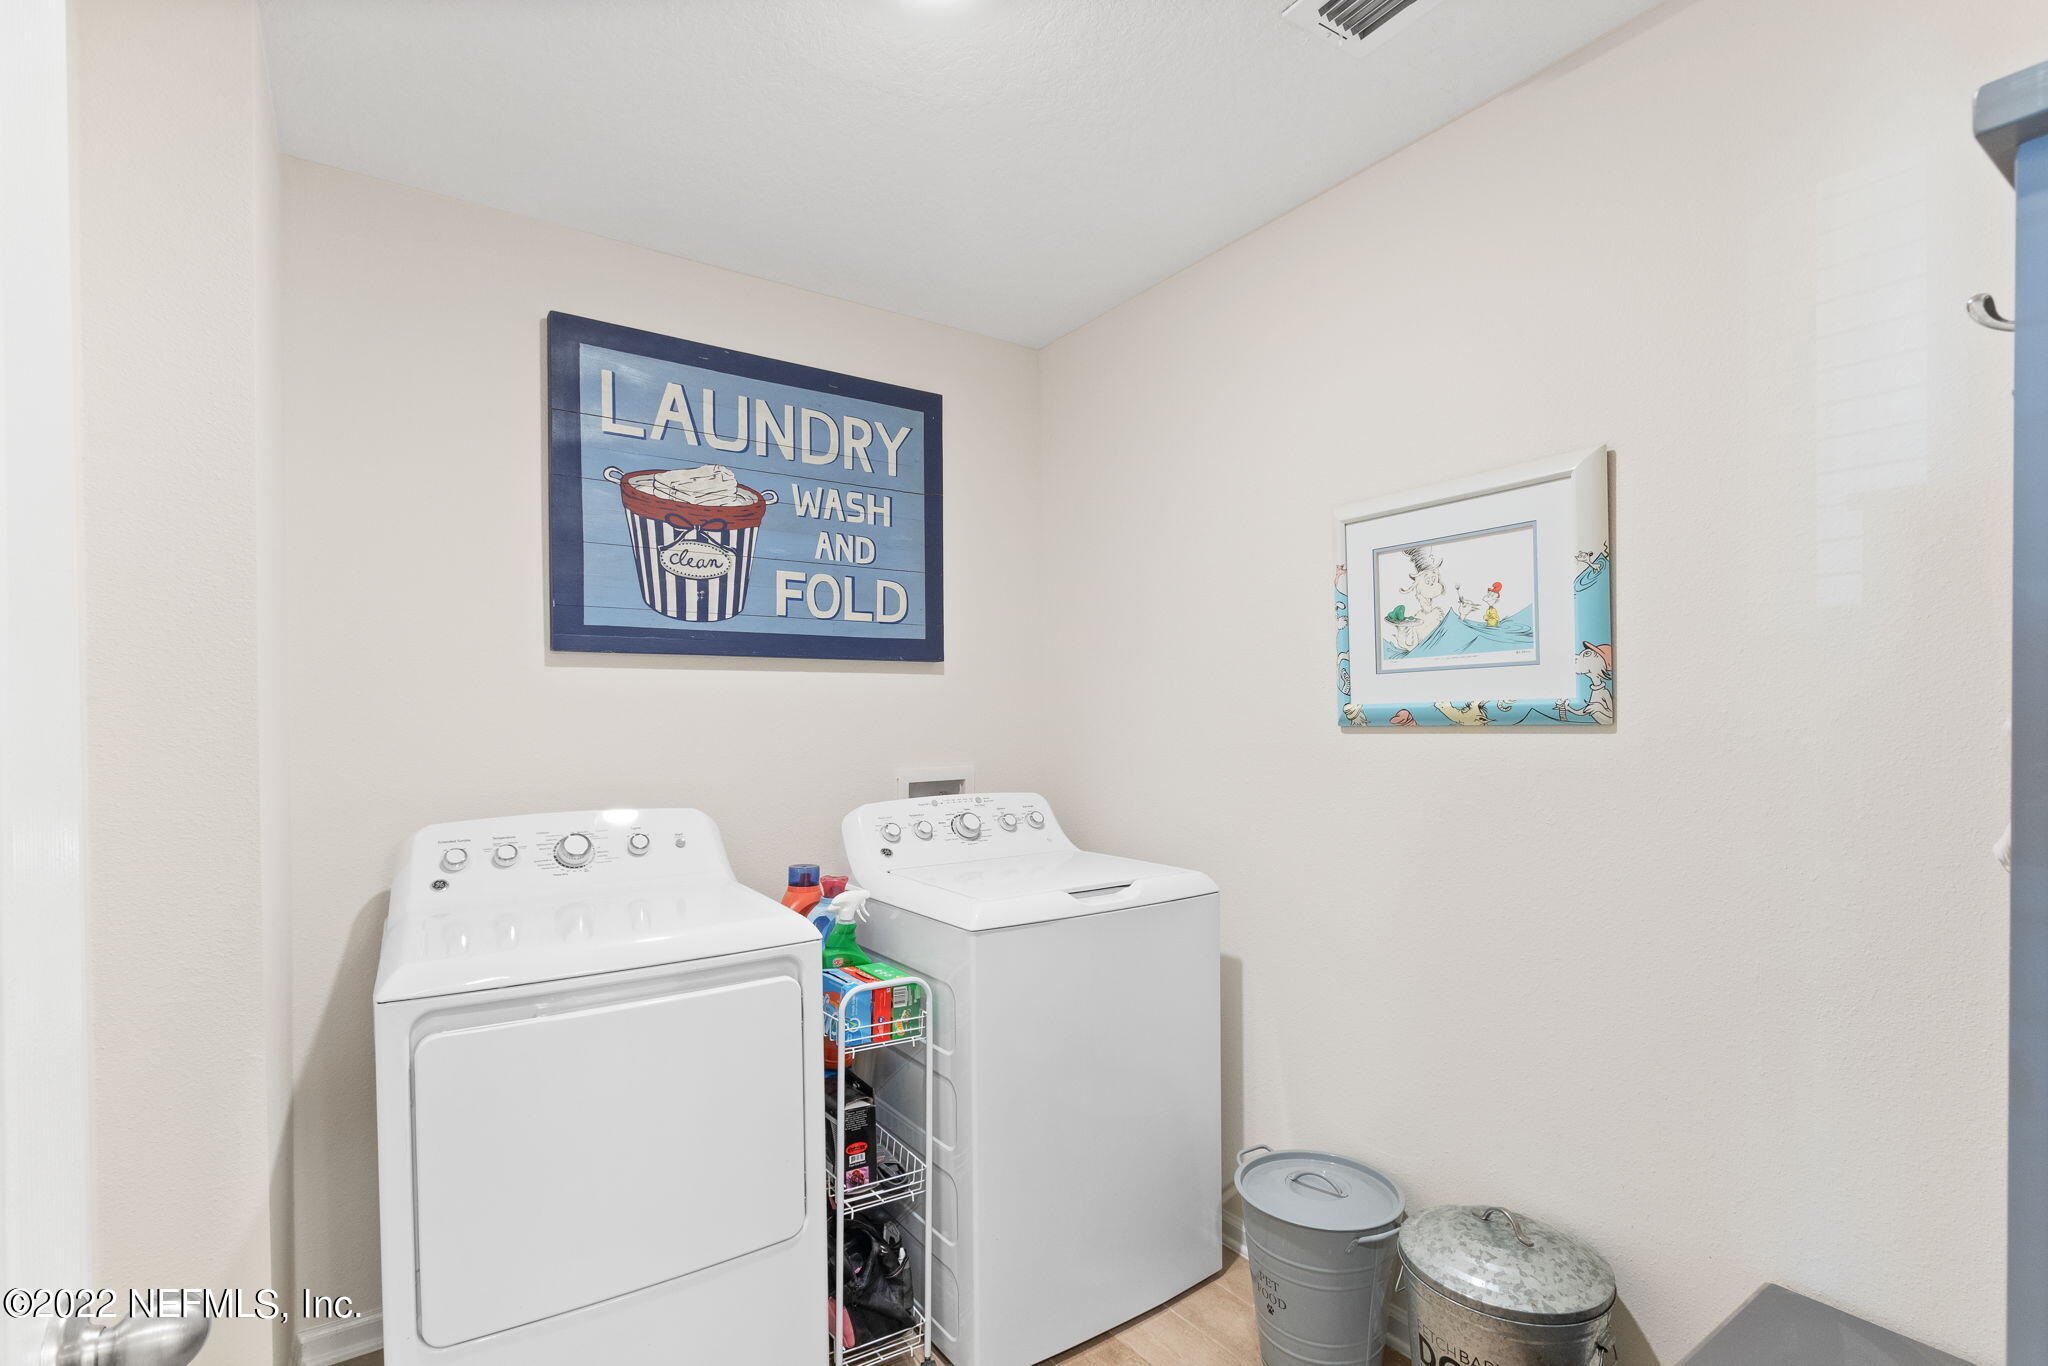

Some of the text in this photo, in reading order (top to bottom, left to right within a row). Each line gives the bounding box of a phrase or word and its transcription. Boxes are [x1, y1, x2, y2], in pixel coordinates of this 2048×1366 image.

[600, 369, 912, 478] LAUNDRY
[791, 483, 893, 528] WASH
[669, 548, 724, 569] clean
[814, 531, 877, 565] AND
[775, 570, 909, 625] FOLD
[1257, 1270, 1280, 1292] PET
[1257, 1282, 1287, 1310] FOOD
